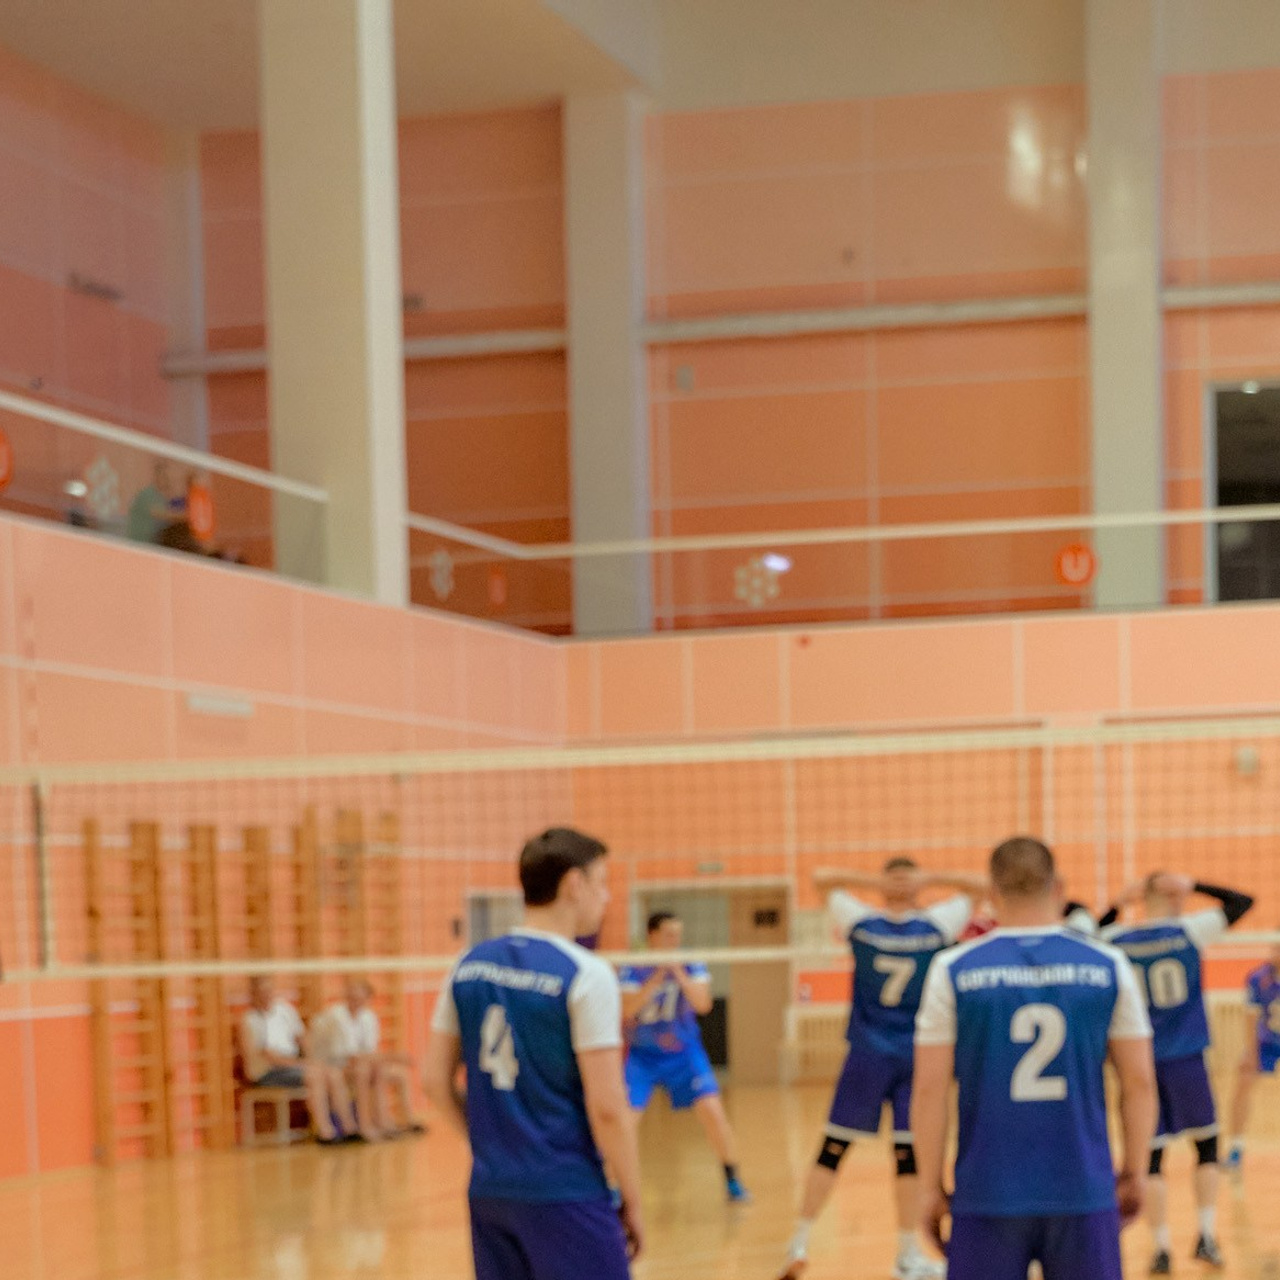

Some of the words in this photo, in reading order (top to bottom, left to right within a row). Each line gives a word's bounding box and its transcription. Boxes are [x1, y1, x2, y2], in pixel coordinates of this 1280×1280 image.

[872, 954, 918, 1008] 7
[479, 1003, 520, 1092] 4
[1009, 1001, 1069, 1102] 2
